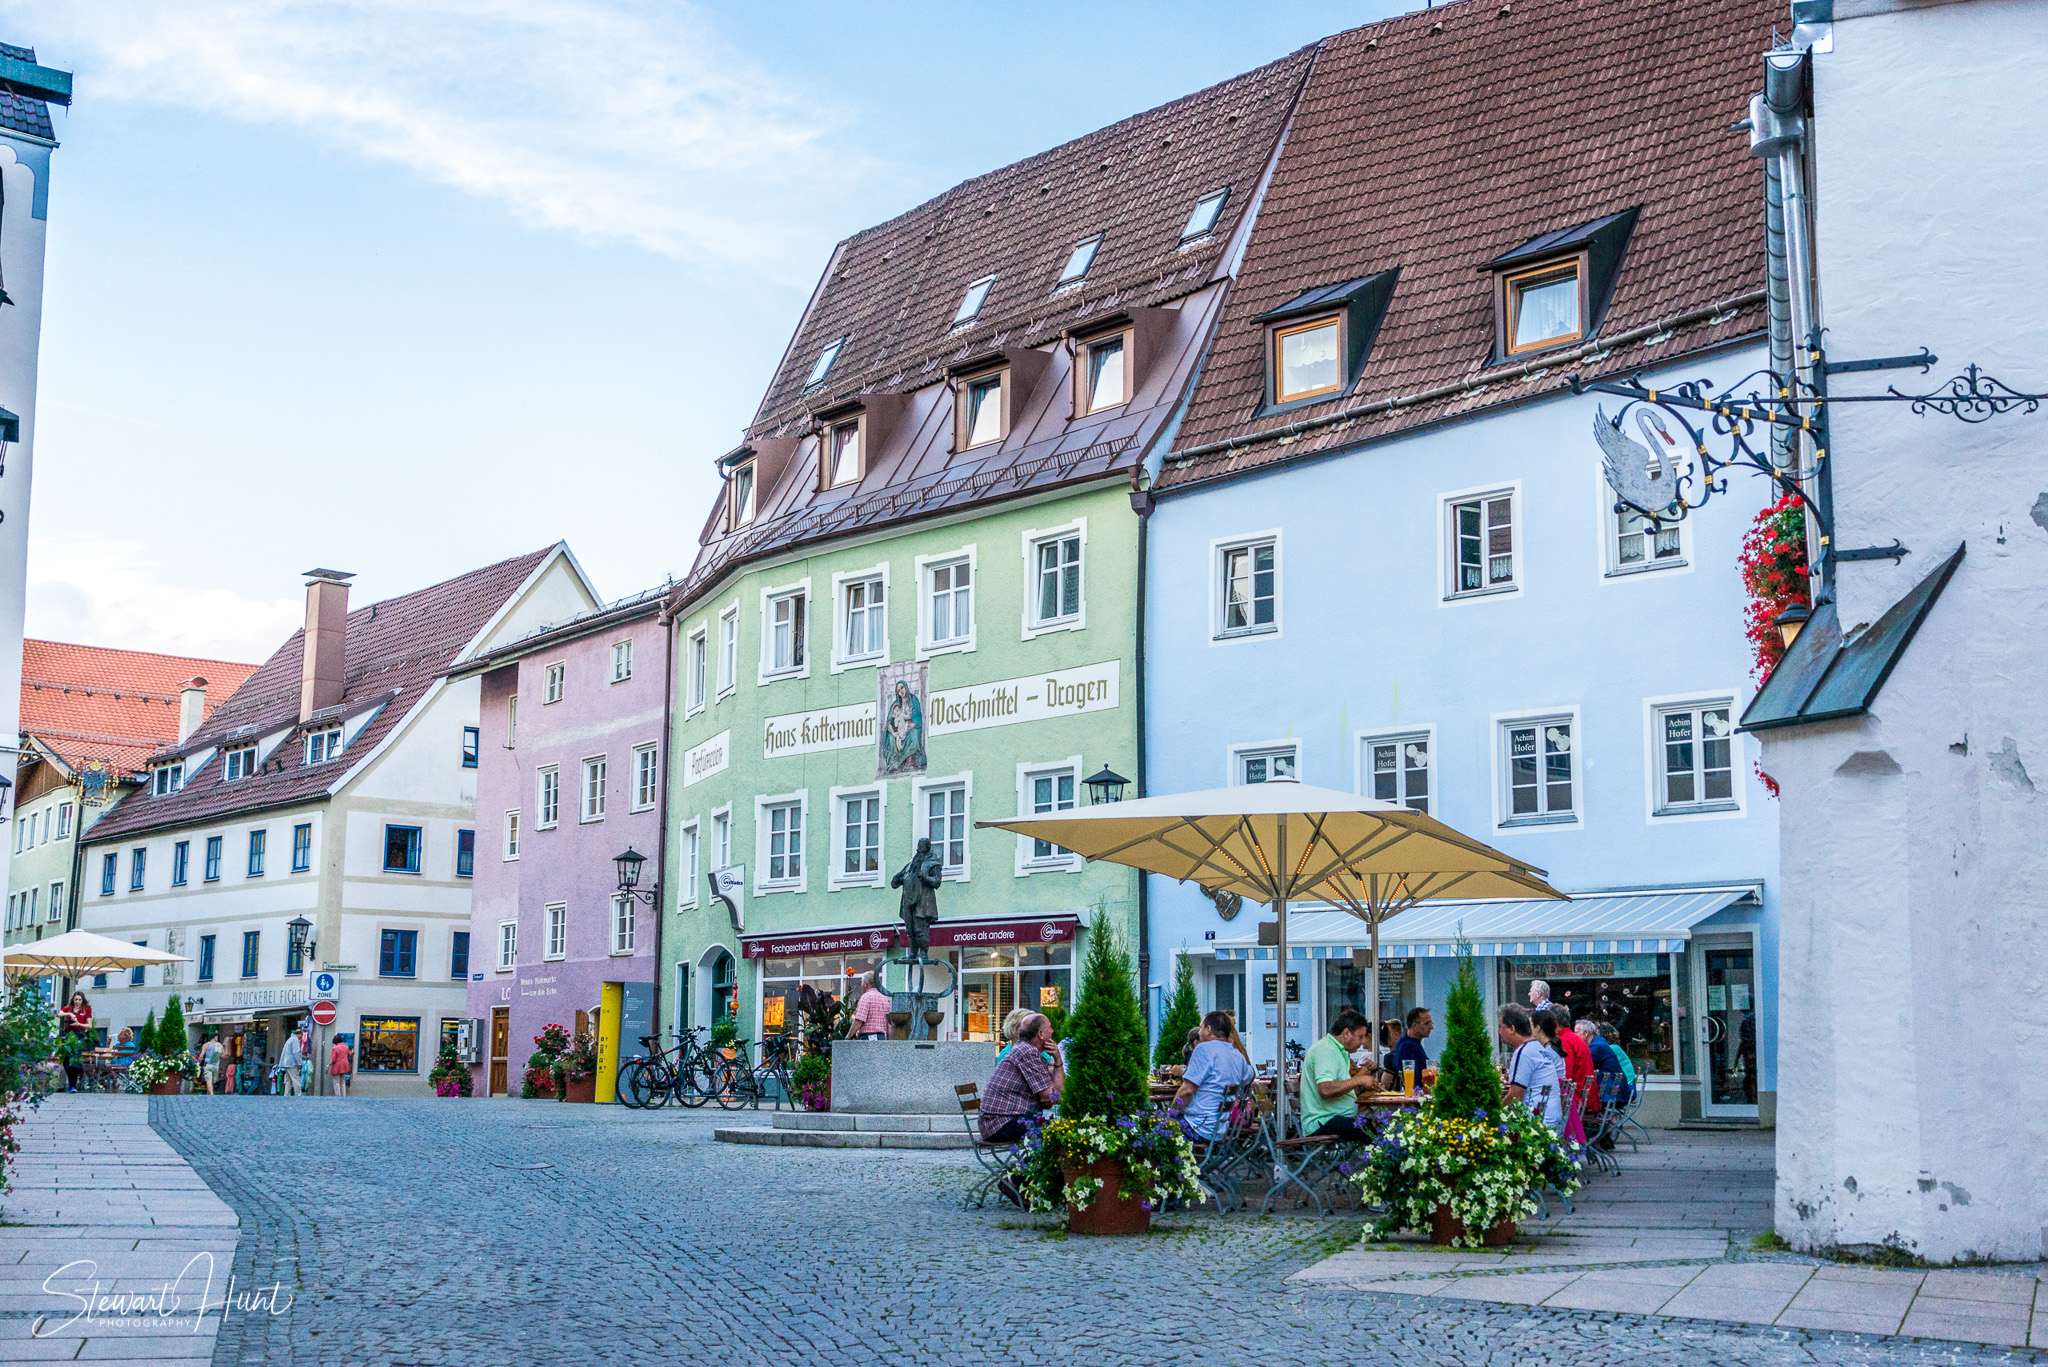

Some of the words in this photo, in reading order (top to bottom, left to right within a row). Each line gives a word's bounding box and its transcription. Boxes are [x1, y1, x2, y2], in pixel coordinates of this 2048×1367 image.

[929, 684, 1019, 727] Waschmittel
[1045, 678, 1108, 710] Drogen
[1668, 718, 1691, 728] Achim
[764, 722, 797, 754] Hans
[800, 708, 876, 745] Kottermair
[1668, 728, 1692, 738] Hofer
[1513, 733, 1535, 742] Achim
[1513, 742, 1536, 752] Hofer
[1376, 750, 1396, 759] Achim
[1376, 759, 1397, 768] Hofer
[953, 931, 977, 942] anders
[977, 930, 988, 941] als
[988, 929, 1015, 940] andere
[771, 941, 811, 955] Fachgeschäft
[811, 941, 820, 951] für
[820, 939, 839, 951] Fairen
[840, 937, 863, 949] Handel
[1518, 963, 1558, 977] SCHAD
[1571, 963, 1613, 976] LORENZ
[232, 990, 277, 1006] DRUCKEREI
[279, 988, 307, 1004] FICHTL
